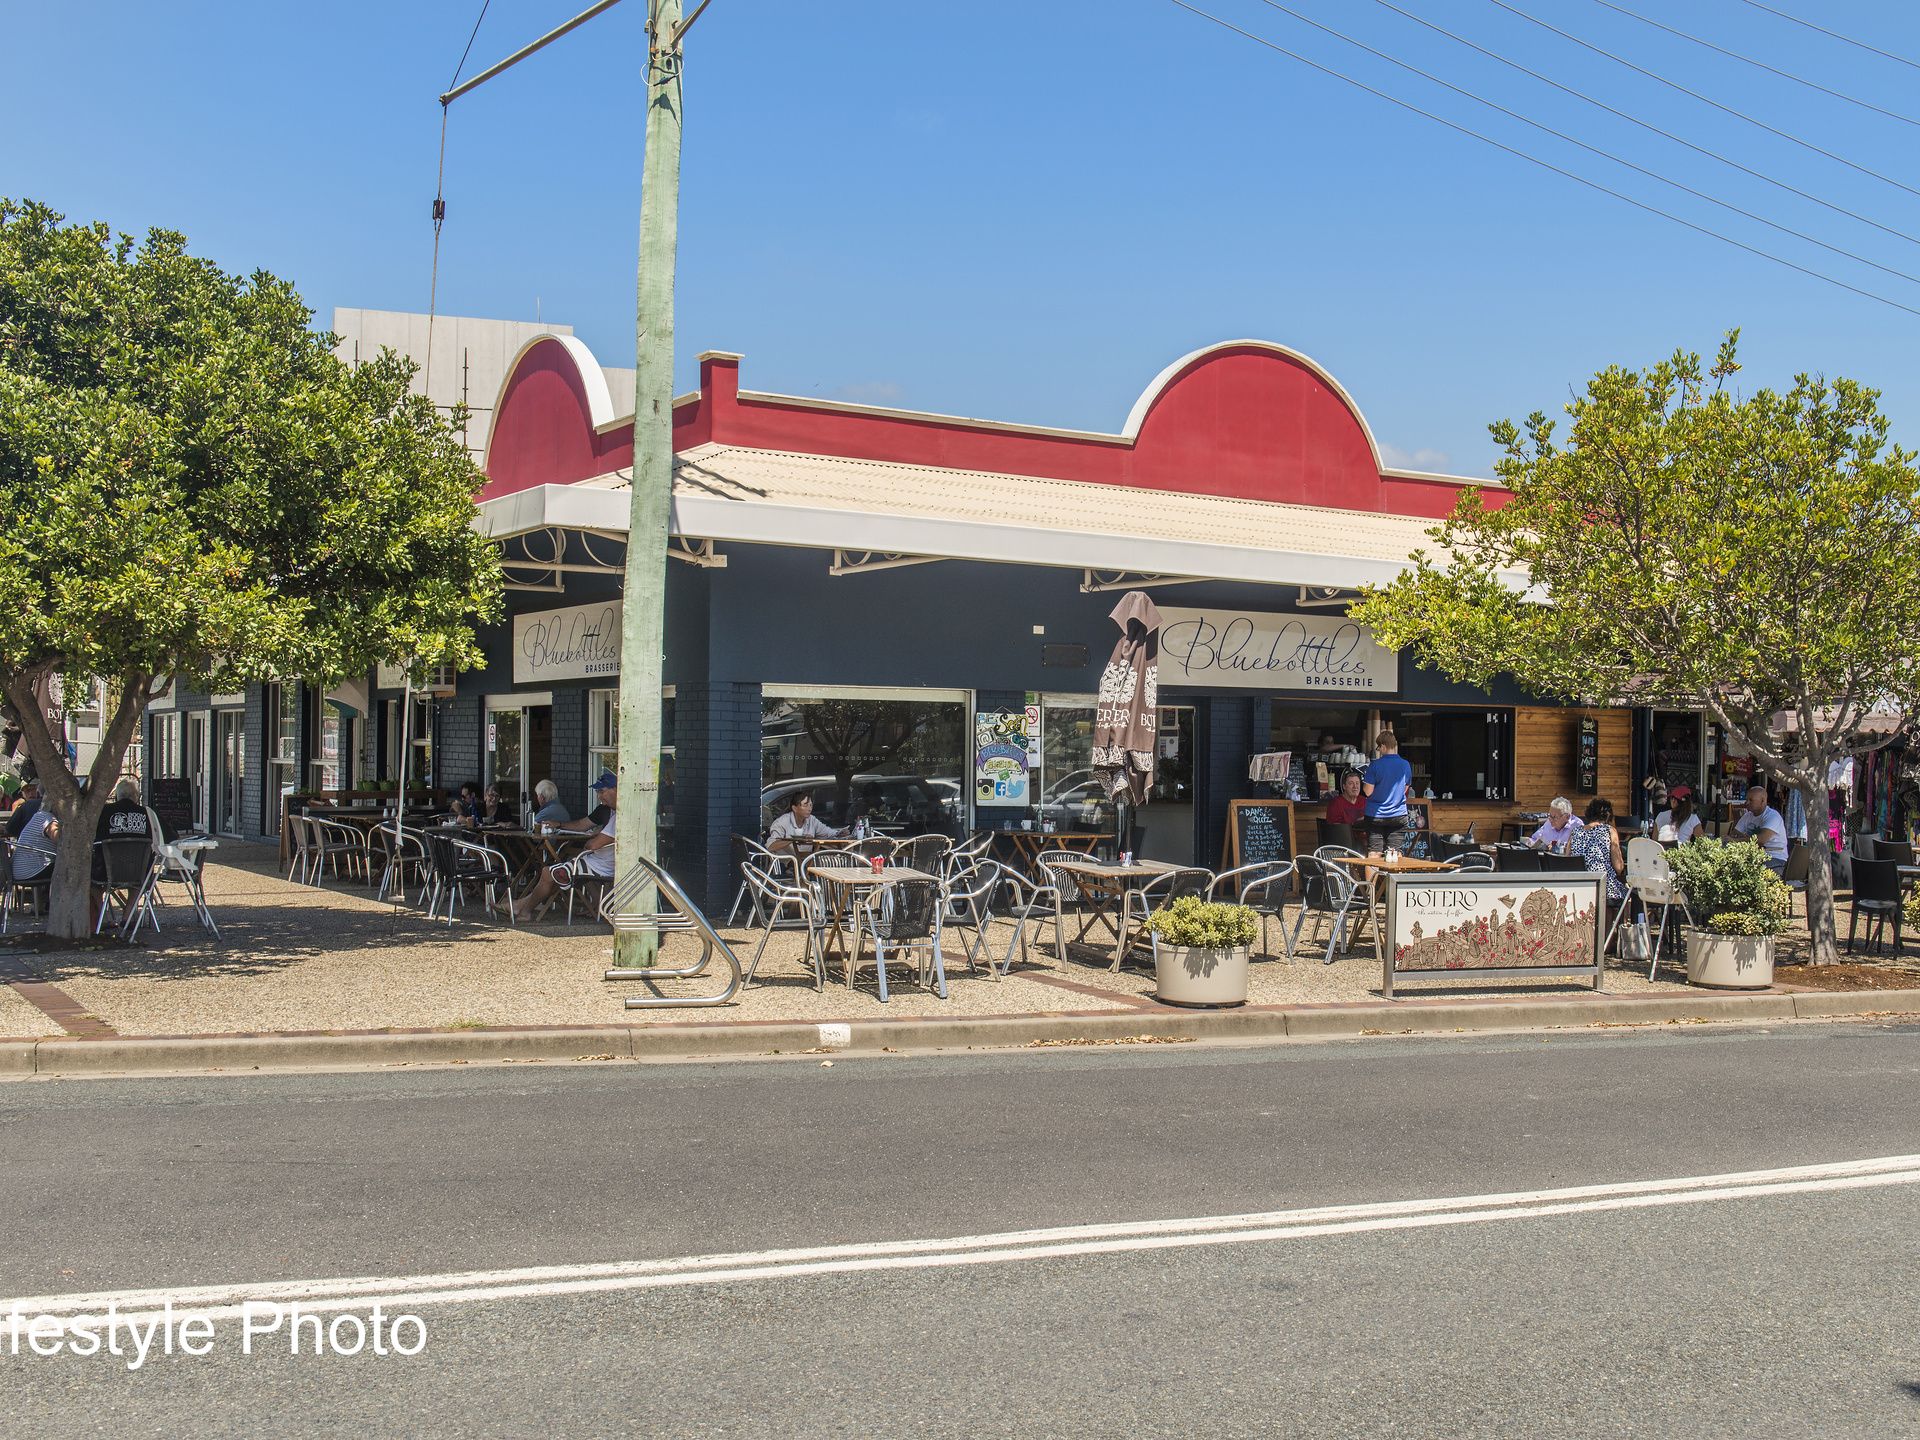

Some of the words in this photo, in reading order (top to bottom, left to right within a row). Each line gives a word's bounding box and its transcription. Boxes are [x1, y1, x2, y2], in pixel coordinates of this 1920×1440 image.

[522, 607, 617, 674] Bluebottles
[1160, 617, 1366, 677] Bluebottles
[585, 661, 620, 674] BRASSERIE
[1306, 676, 1373, 687] BRASSERIE
[1405, 889, 1478, 911] BOTERO
